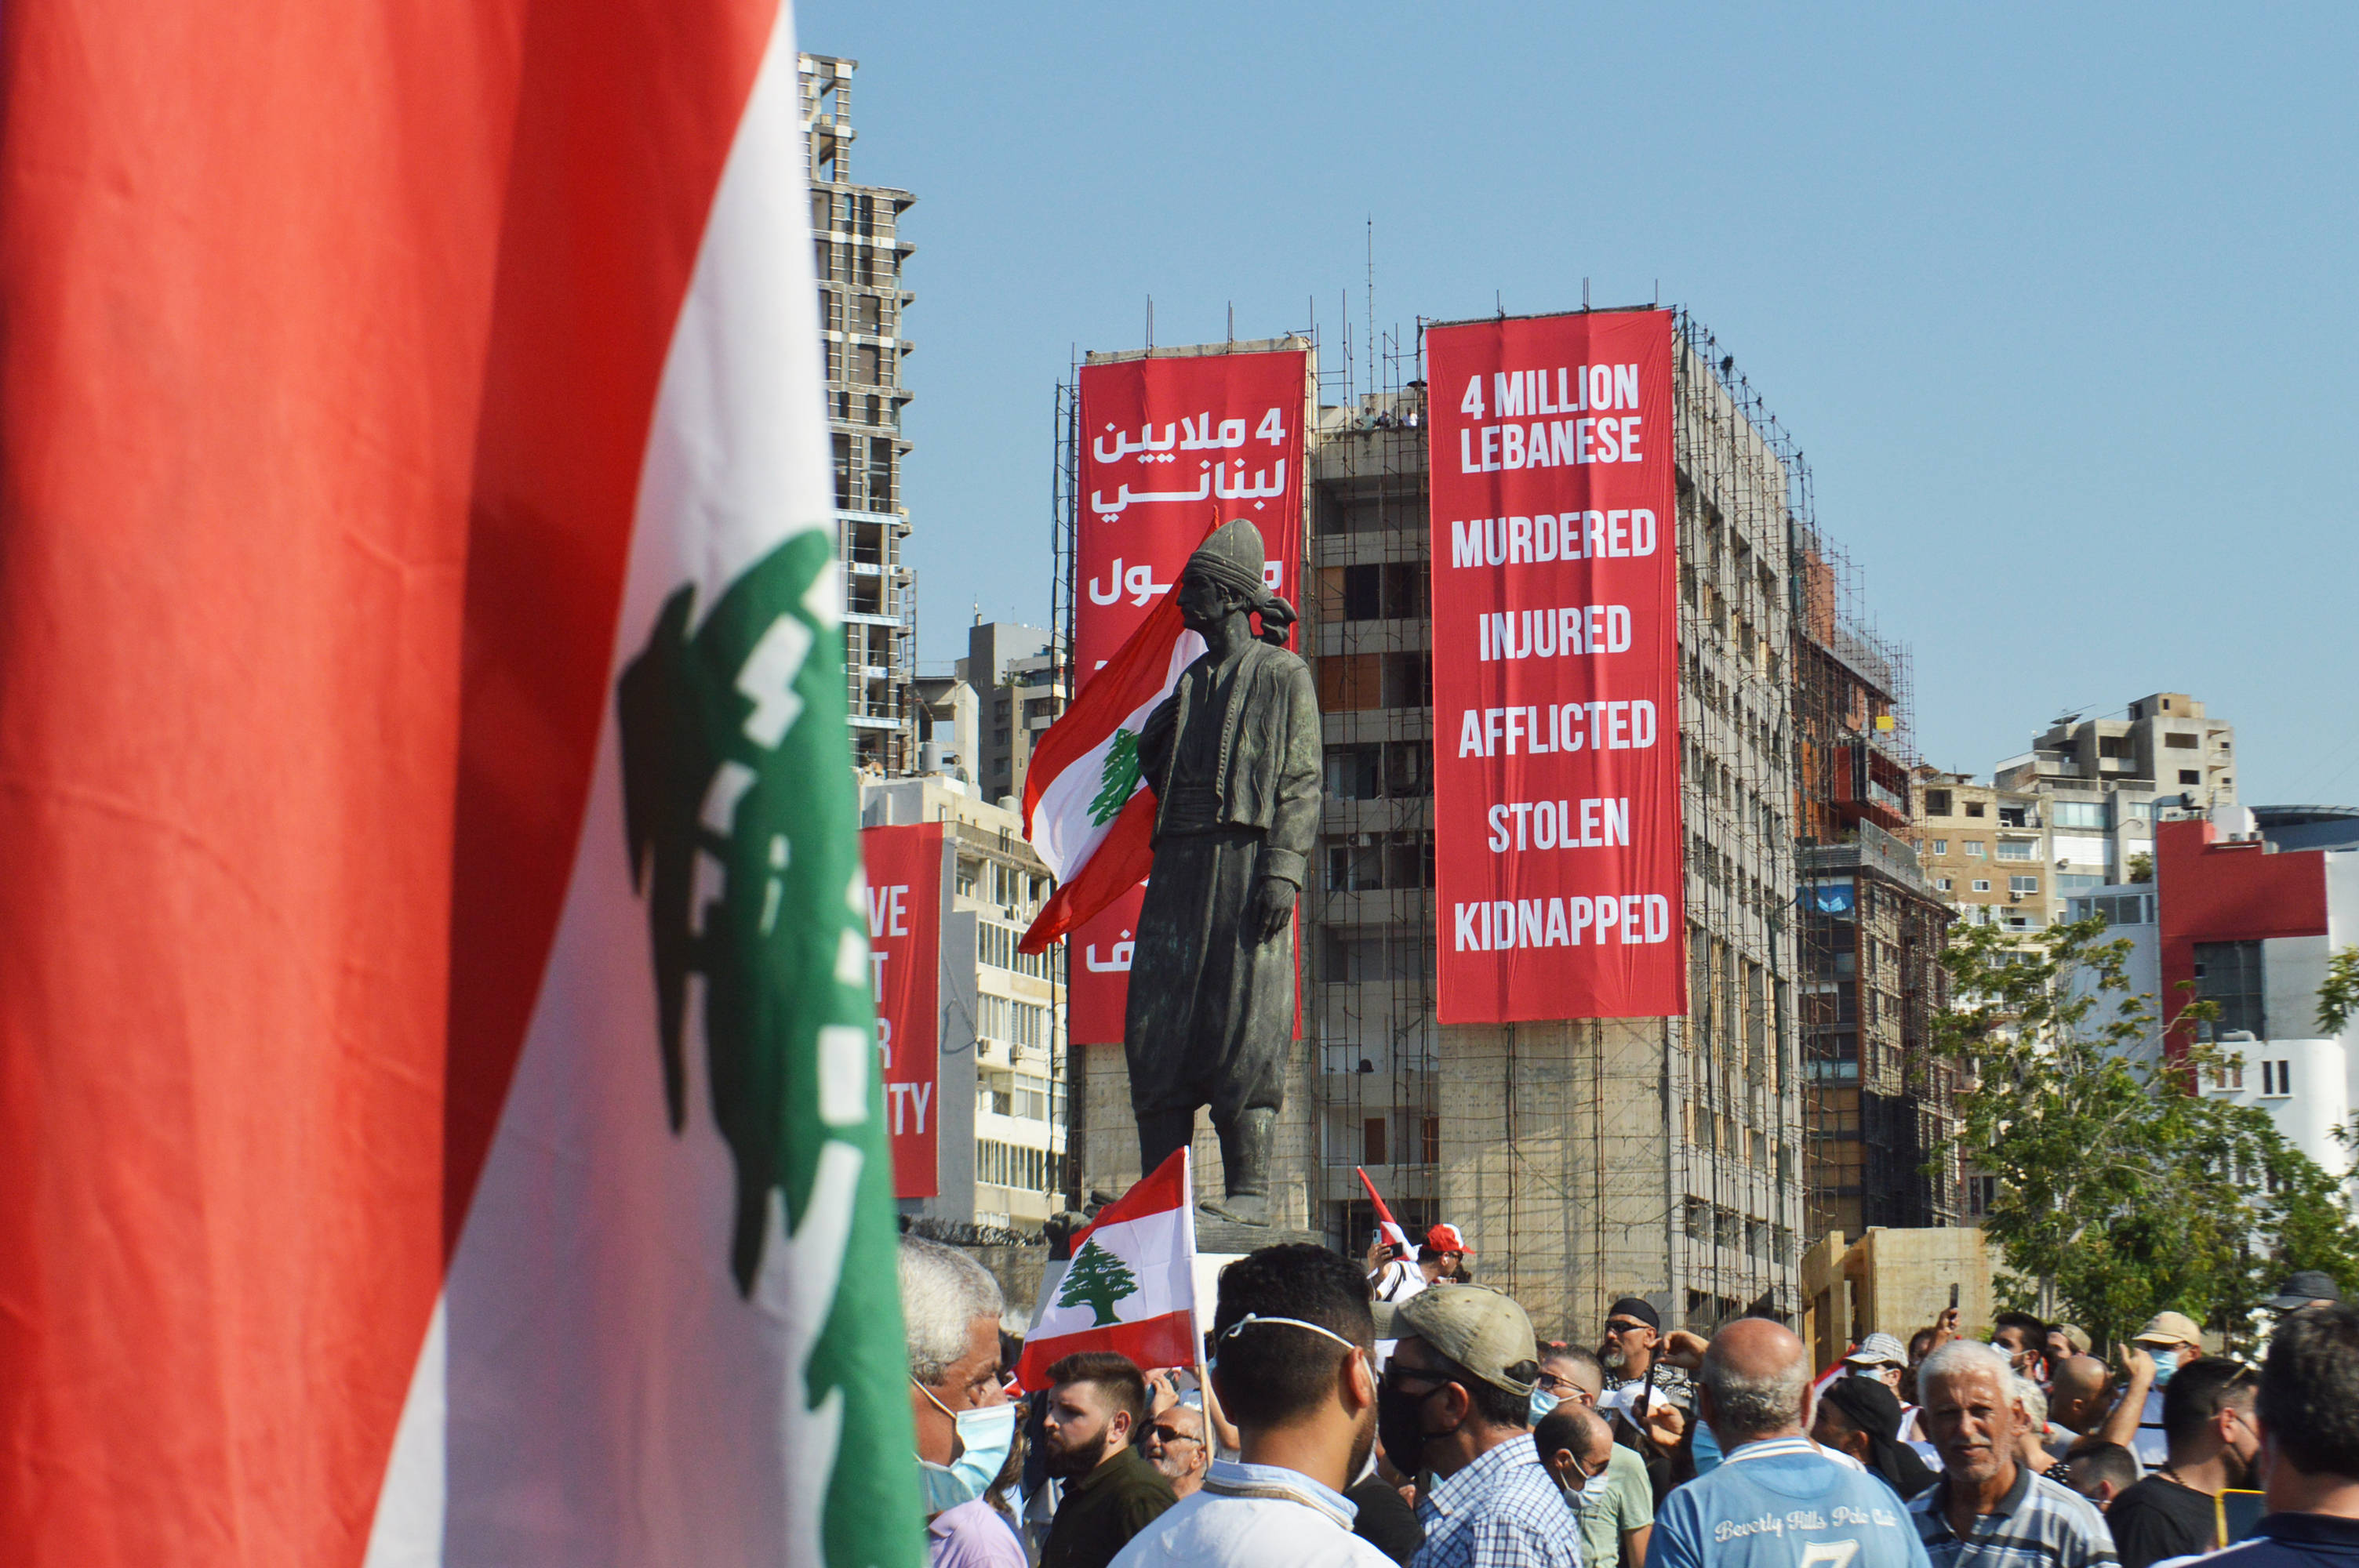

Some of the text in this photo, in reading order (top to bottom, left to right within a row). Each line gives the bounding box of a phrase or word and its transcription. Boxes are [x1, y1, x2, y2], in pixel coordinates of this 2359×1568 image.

[1460, 363, 1639, 420] 4 MILLION
[1093, 407, 1286, 464] 4 ملايين
[1460, 416, 1643, 474] LEBANESE
[1091, 457, 1285, 524] لبناني
[1451, 508, 1656, 568] MURDERED
[1479, 604, 1632, 662] INJURED
[1458, 699, 1656, 758] AFFLICTED
[1488, 797, 1630, 853] STOLEN
[1455, 894, 1669, 952] KIDNAPPED
[1714, 1512, 1783, 1542] Beverly
[1786, 1510, 1828, 1530] Hills
[1832, 1506, 1870, 1527] Polo
